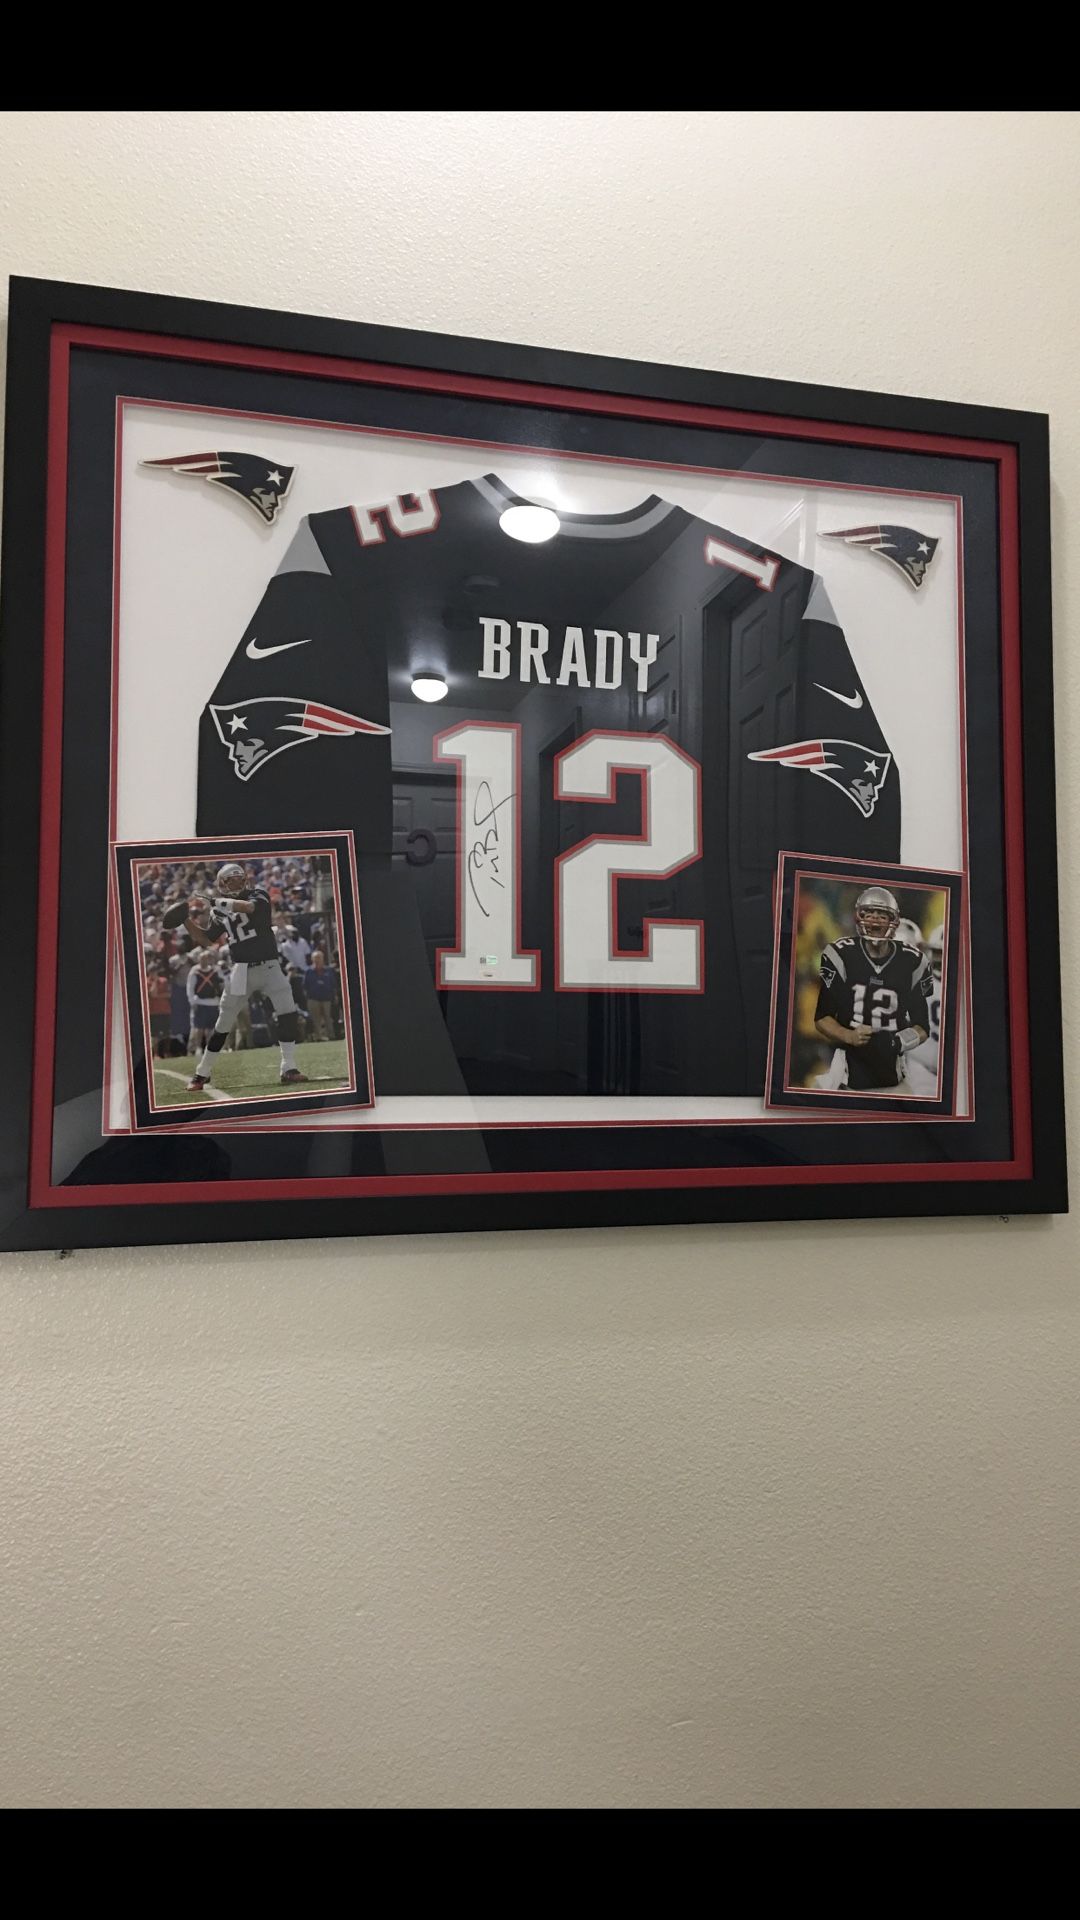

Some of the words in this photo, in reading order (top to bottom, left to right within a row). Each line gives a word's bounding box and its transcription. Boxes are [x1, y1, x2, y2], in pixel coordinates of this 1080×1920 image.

[703, 536, 780, 592] 1
[478, 617, 660, 693] BRADY
[433, 721, 704, 994] 12
[850, 984, 898, 1031] 12
